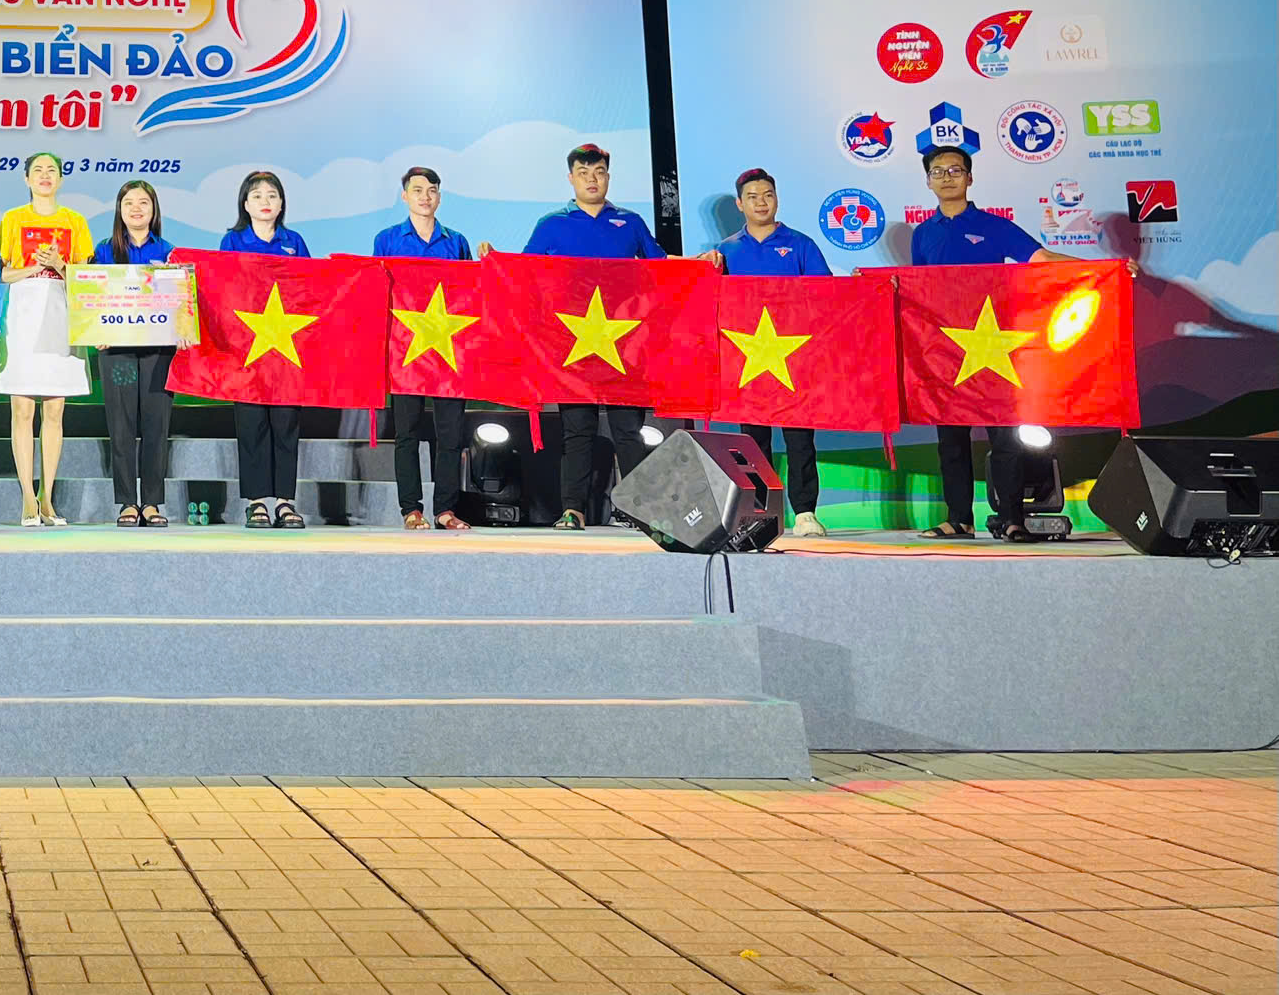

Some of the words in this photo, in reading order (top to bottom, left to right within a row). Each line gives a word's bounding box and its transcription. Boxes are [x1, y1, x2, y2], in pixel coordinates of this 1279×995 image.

[1, 23, 112, 76] BIỂN
[126, 33, 233, 78] ĐẢO
[1088, 104, 1151, 127] YSS
[936, 125, 959, 137] BK
[847, 136, 871, 145] YBA
[79, 158, 90, 172] 3
[95, 158, 134, 172] năm
[139, 159, 181, 173] 2025
[101, 314, 124, 324] 500
